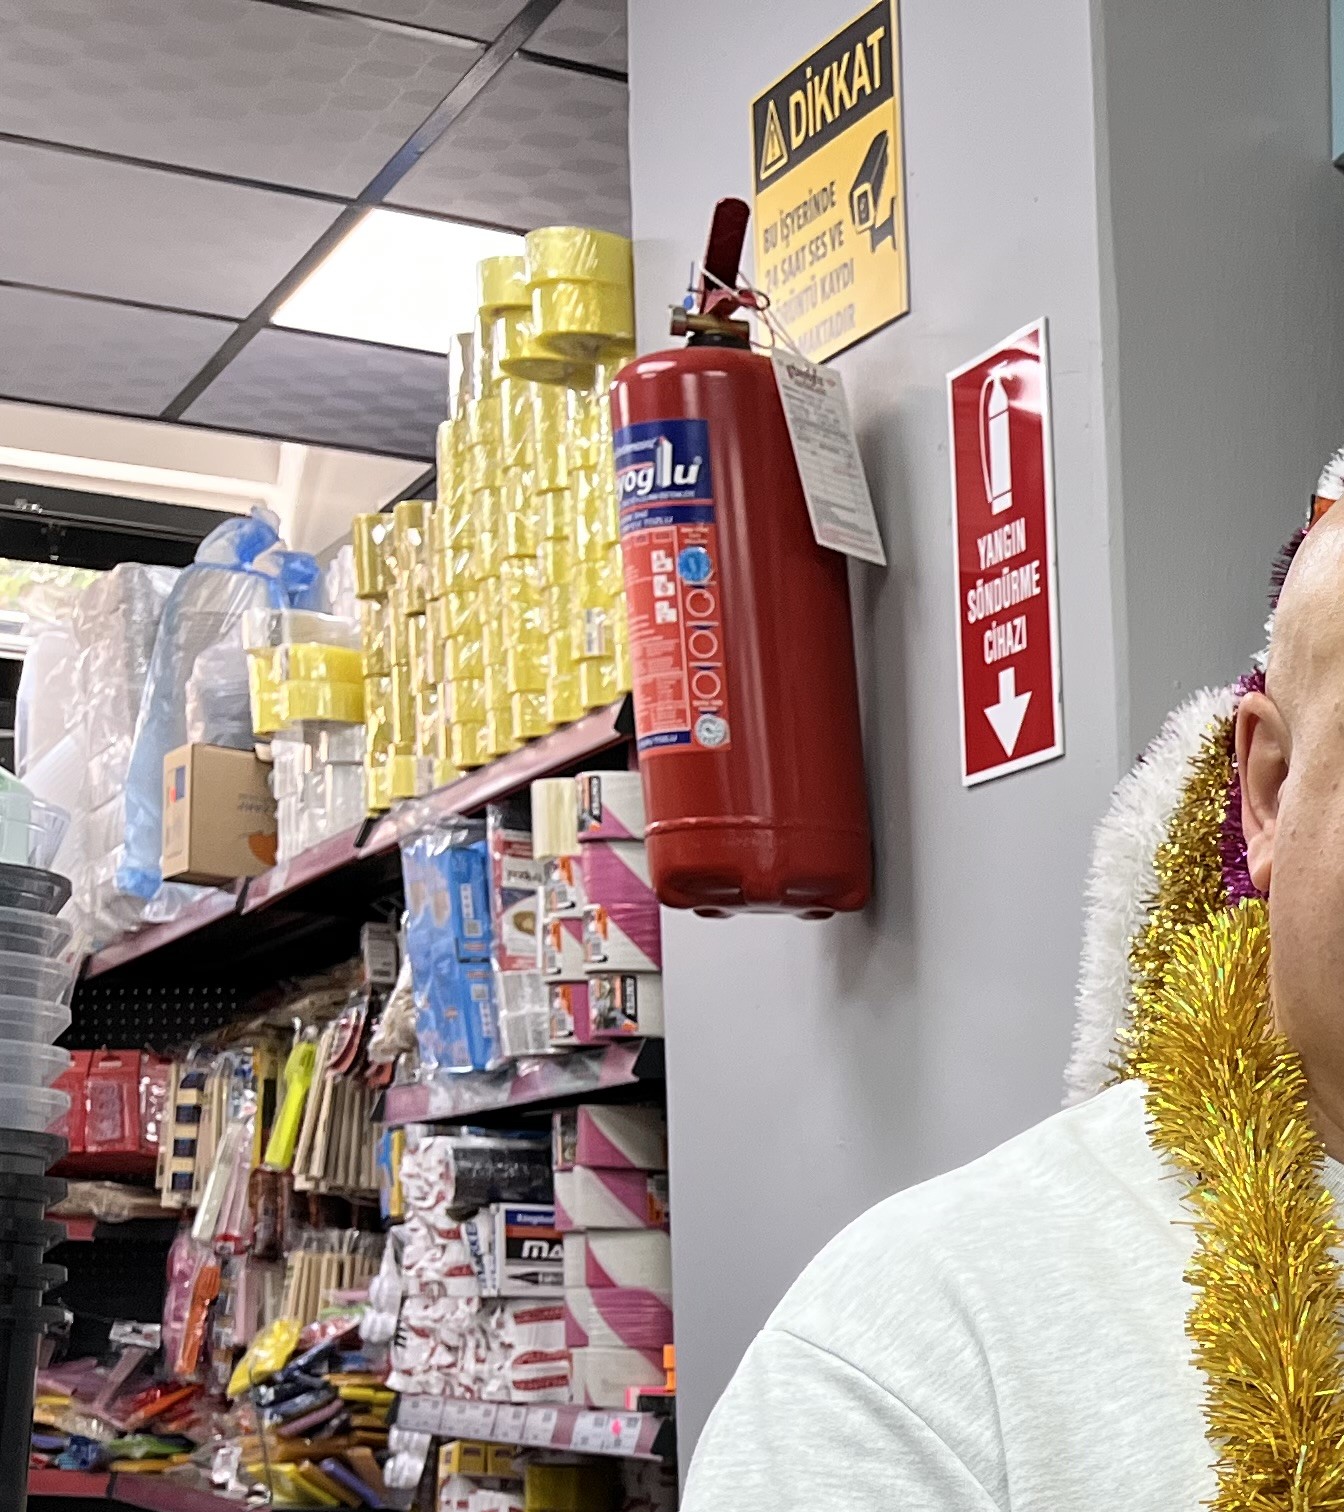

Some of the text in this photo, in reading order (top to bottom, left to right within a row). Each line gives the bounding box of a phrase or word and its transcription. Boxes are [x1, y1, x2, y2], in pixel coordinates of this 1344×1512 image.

[789, 26, 885, 150] DİKKAT
[764, 222, 778, 254] BU
[977, 519, 1027, 571] YANGIN
[966, 566, 1041, 624] SÖNDÜRME
[982, 622, 1027, 666] CİHAZI
